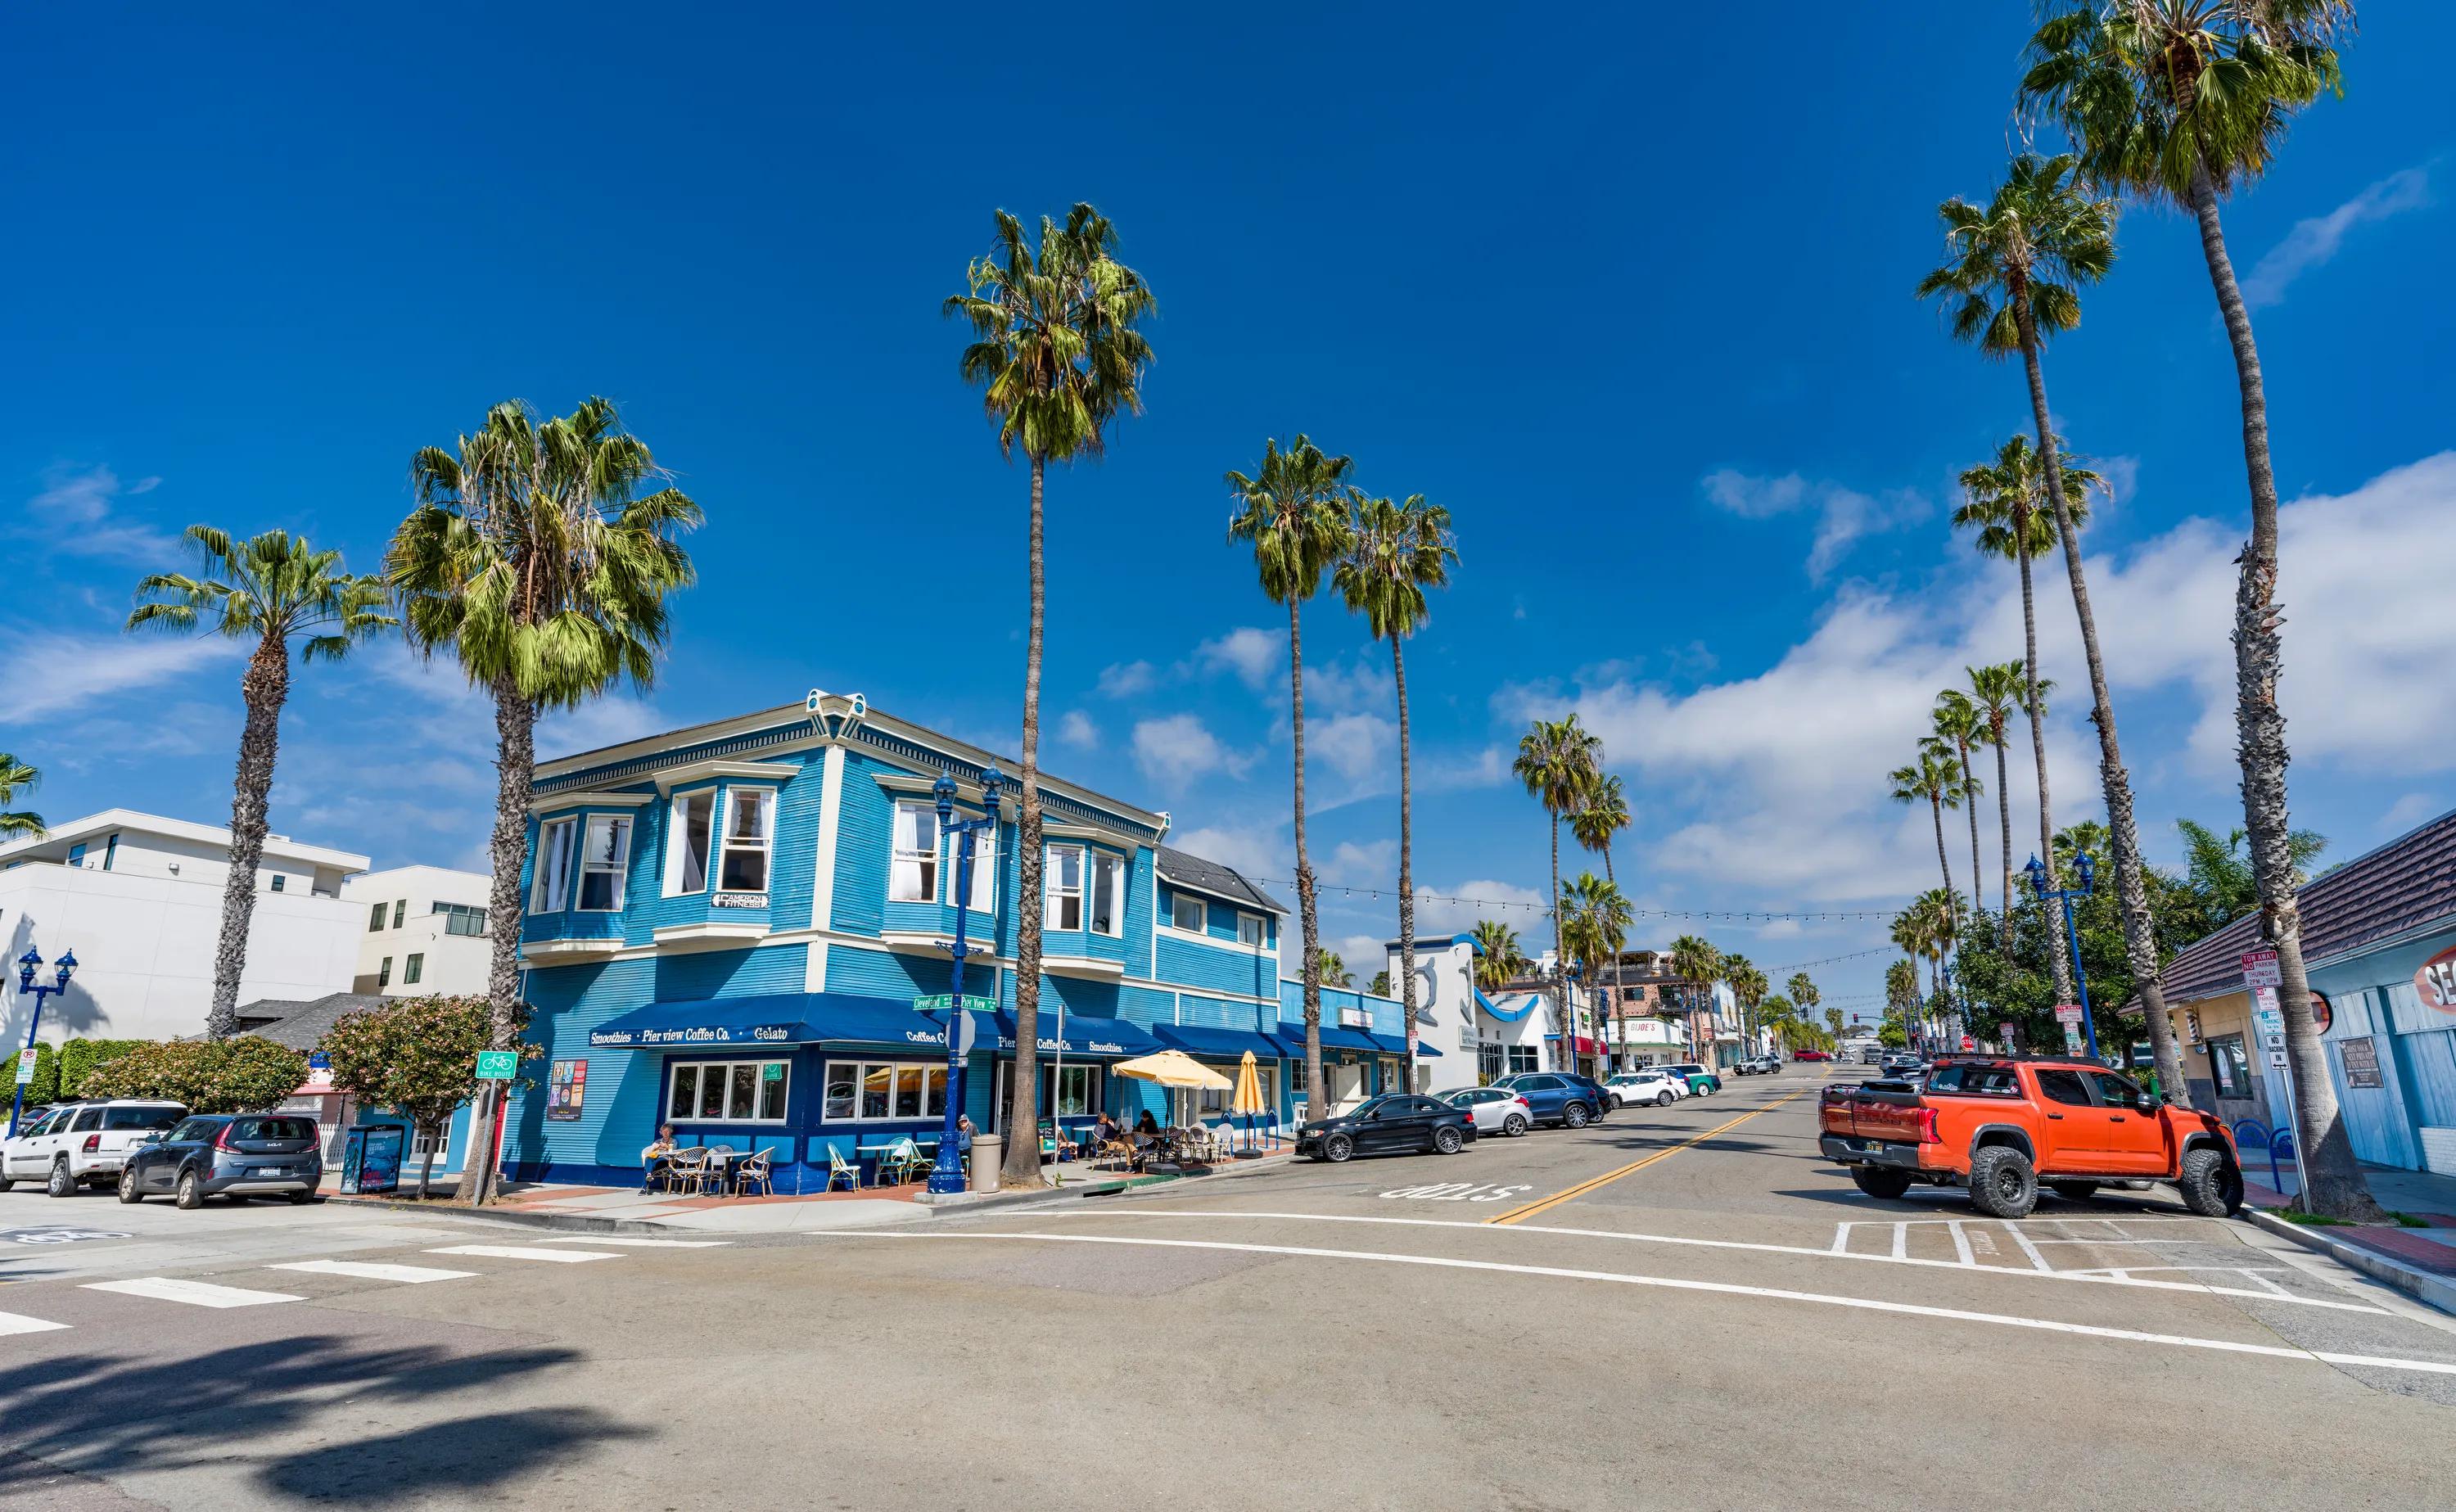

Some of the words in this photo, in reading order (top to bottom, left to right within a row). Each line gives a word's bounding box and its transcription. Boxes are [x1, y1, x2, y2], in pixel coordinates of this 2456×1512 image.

[2258, 952, 2274, 960] AWAY
[914, 998, 940, 1009] Cleveland
[961, 996, 972, 1008] Pier
[974, 998, 986, 1009] View
[591, 1031, 632, 1045] Smoothies
[642, 1029, 661, 1042] Pier
[662, 1030, 684, 1042] view
[685, 1027, 714, 1041] Coffee
[716, 1027, 730, 1040] Co.
[754, 1027, 788, 1040] Gelato
[905, 1031, 937, 1043] Coffee
[997, 1036, 1016, 1048] Pier
[1061, 1040, 1072, 1050] Co.
[1089, 1041, 1122, 1053] Smoothies
[2275, 1054, 2282, 1062] IN
[1379, 1182, 1533, 1202] STOP
